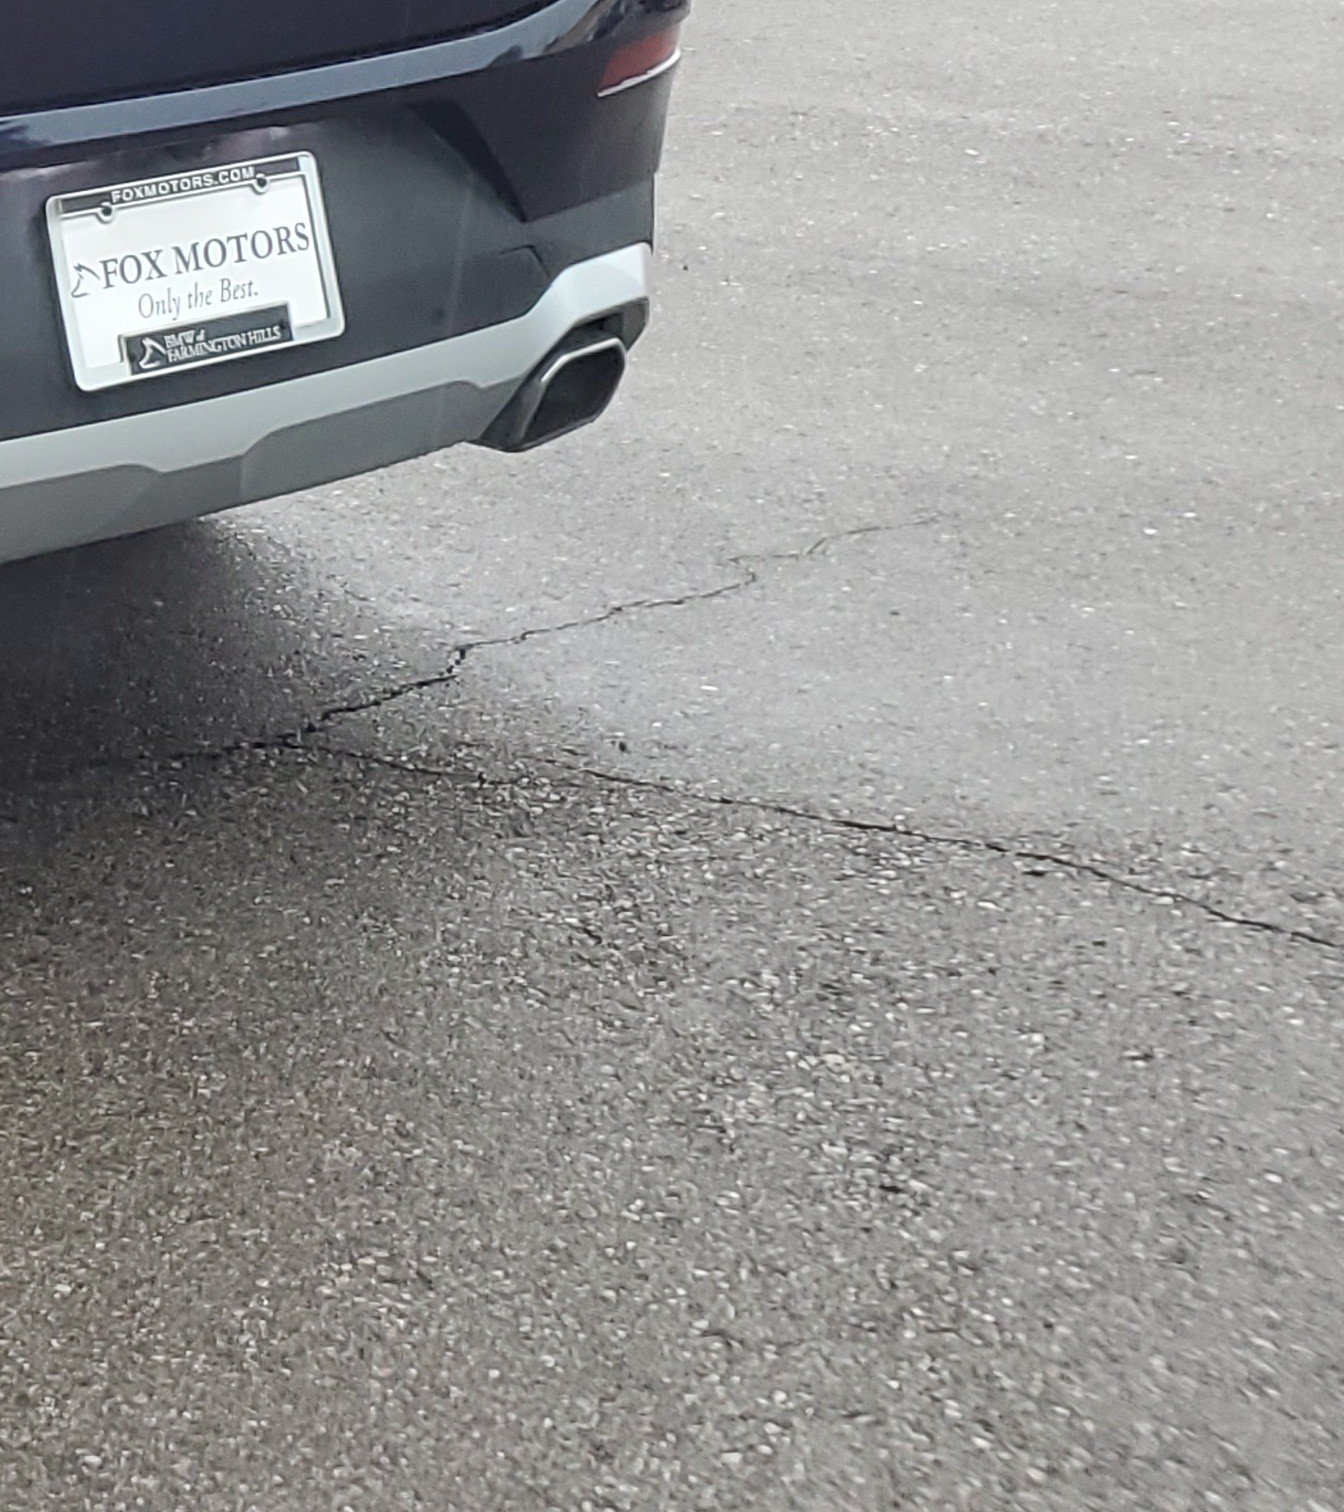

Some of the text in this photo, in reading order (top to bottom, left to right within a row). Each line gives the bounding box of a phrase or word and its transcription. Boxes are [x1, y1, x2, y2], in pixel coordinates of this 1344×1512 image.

[111, 166, 256, 204] FOXMOTORS.COM
[99, 222, 310, 290] FOX MOTORS
[137, 277, 260, 321] Only the Best.
[163, 330, 196, 350] BMW
[166, 325, 283, 364] FARMINGTON HILLS
